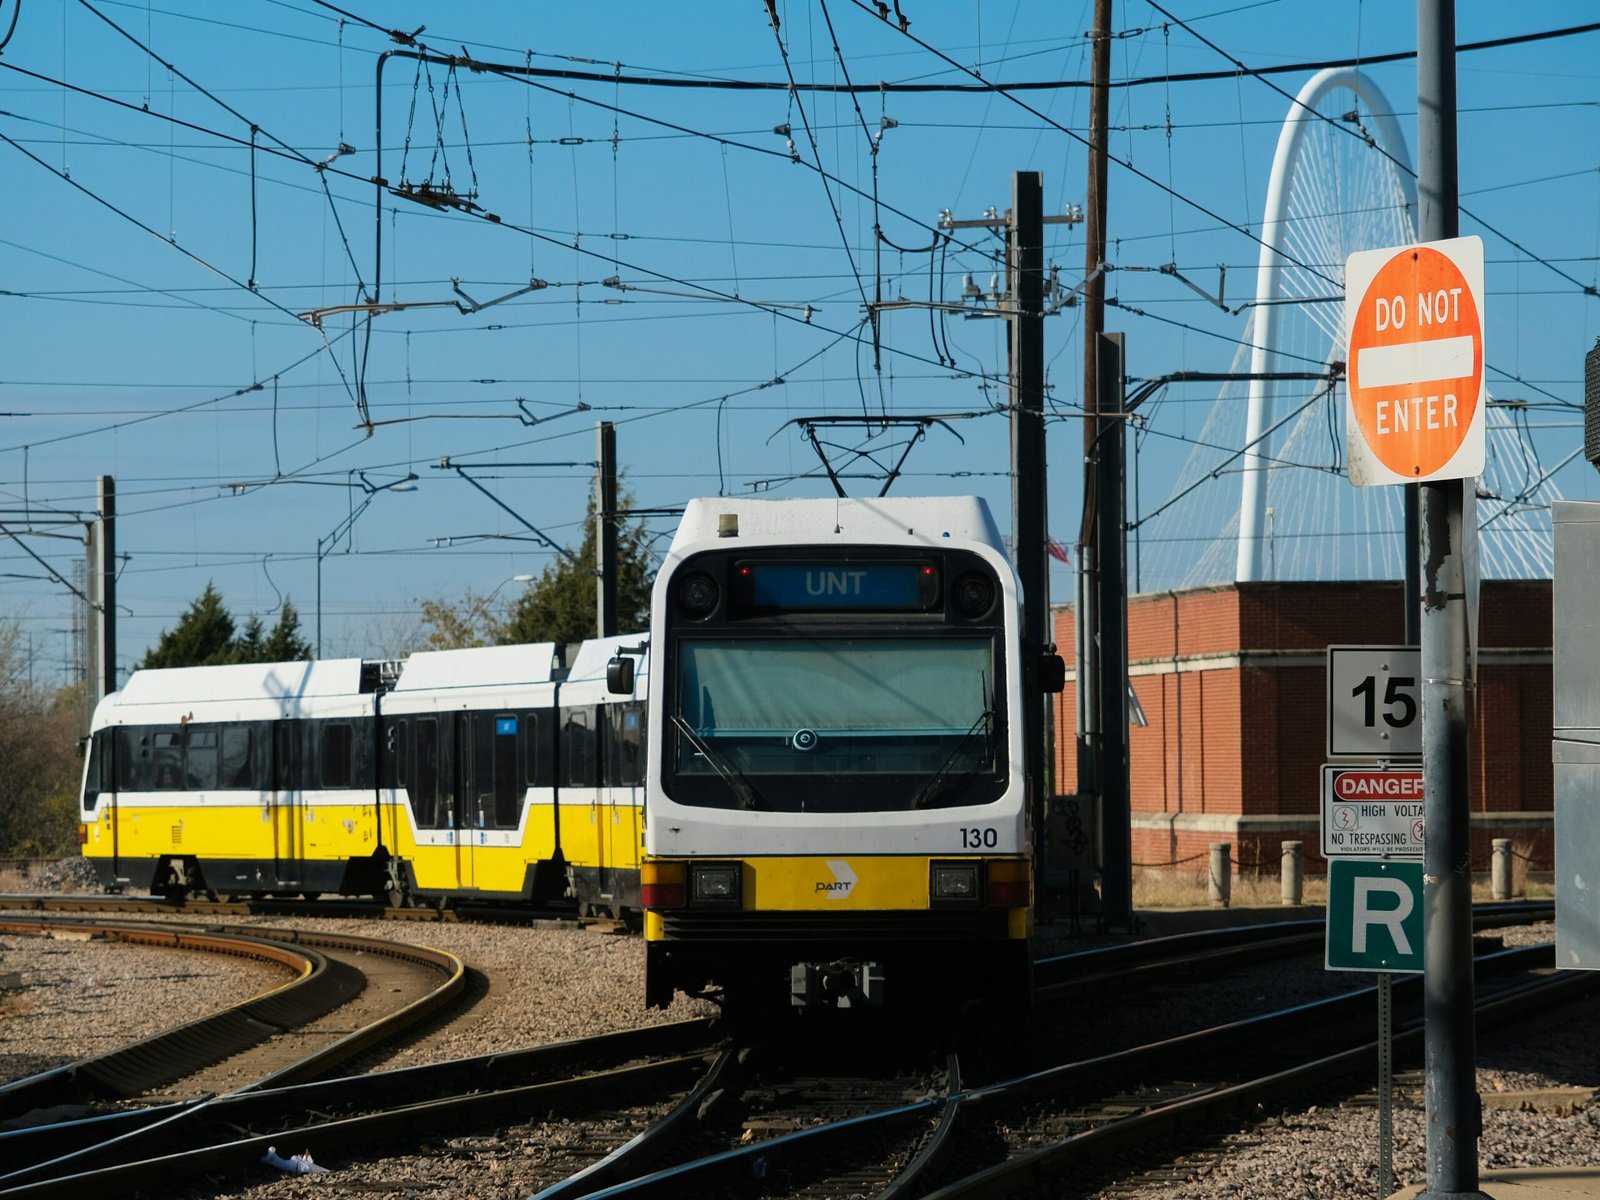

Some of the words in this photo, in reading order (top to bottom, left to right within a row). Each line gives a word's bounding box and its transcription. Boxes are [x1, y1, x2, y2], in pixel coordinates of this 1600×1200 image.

[1375, 295, 1406, 332] DO
[1418, 287, 1462, 327] NOT
[1376, 394, 1458, 435] ENTER
[806, 571, 868, 595] UNT
[1352, 676, 1417, 728] 15
[1361, 805, 1386, 817] HIGH
[960, 828, 998, 848] 130
[1331, 833, 1344, 845] NO
[1349, 833, 1407, 845] TRESPASSING
[815, 882, 852, 892] DART
[1352, 876, 1415, 955] R
